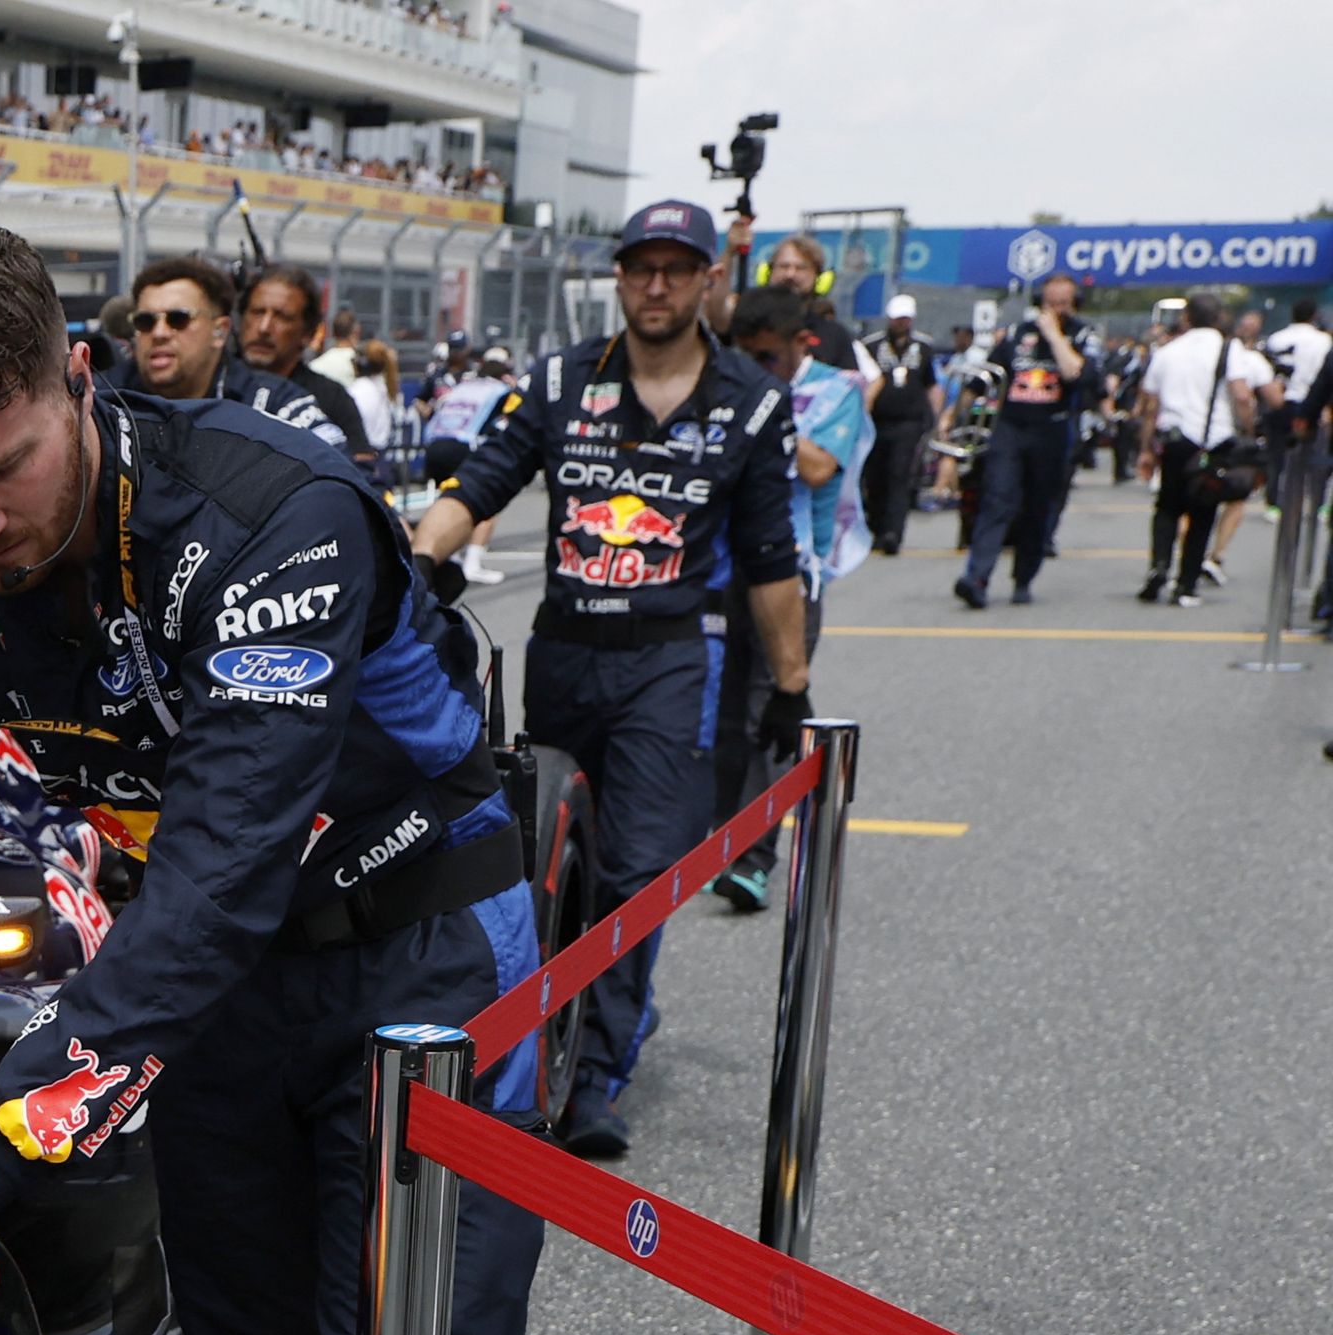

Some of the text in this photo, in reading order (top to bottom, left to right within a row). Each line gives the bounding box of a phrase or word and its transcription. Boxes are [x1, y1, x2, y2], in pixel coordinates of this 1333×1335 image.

[1067, 232, 1317, 284] crypto.com
[557, 460, 713, 505] ORACLE
[162, 541, 211, 643] sparco
[215, 584, 341, 644] ROKT
[129, 620, 151, 671] ACCESS
[232, 649, 308, 684] Ford
[209, 685, 328, 709] RACING
[332, 809, 431, 890] C. ADAMS
[77, 1053, 166, 1159] Red Bull
[629, 1199, 656, 1256] hp
